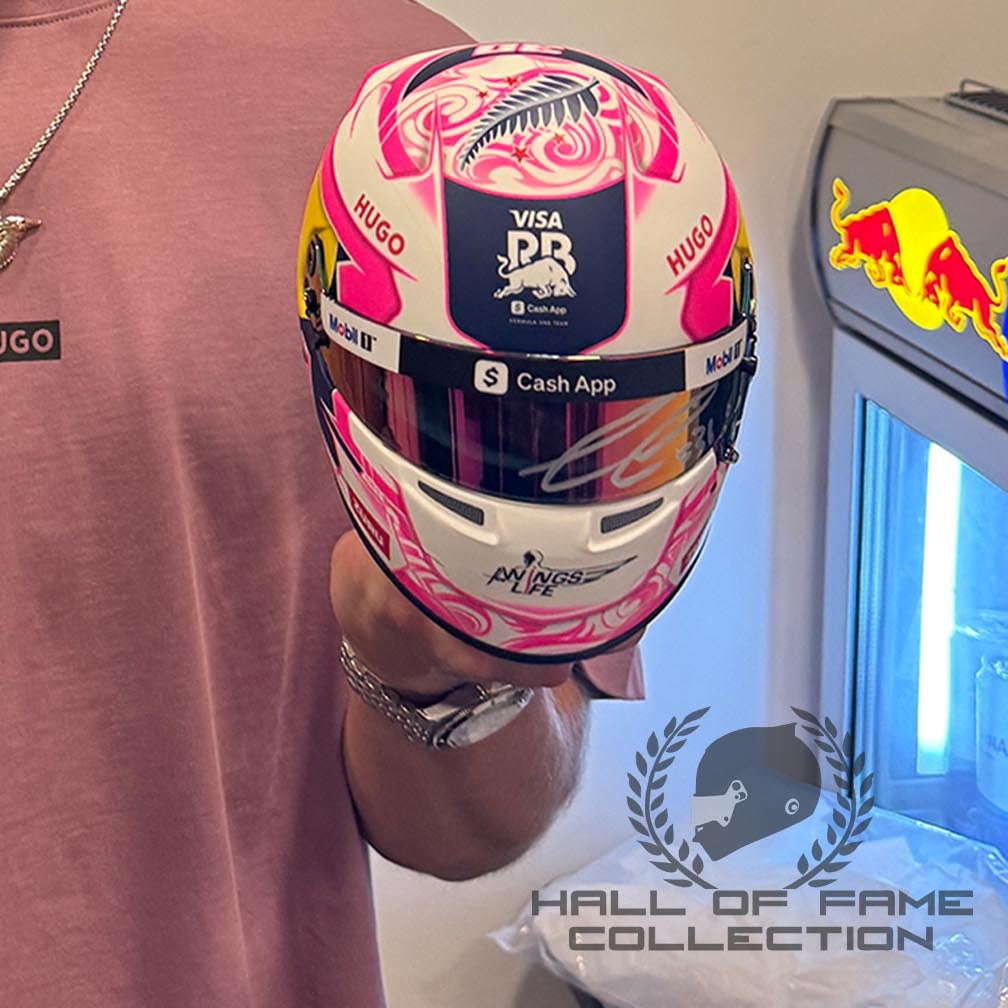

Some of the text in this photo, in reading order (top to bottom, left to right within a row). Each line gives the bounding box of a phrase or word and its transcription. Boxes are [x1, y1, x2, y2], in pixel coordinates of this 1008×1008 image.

[353, 194, 405, 256] HUGO
[509, 210, 563, 229] VISA
[666, 214, 713, 277] HUGO
[328, 313, 358, 345] Mobil
[517, 372, 570, 393] Cash
[575, 375, 617, 396] App
